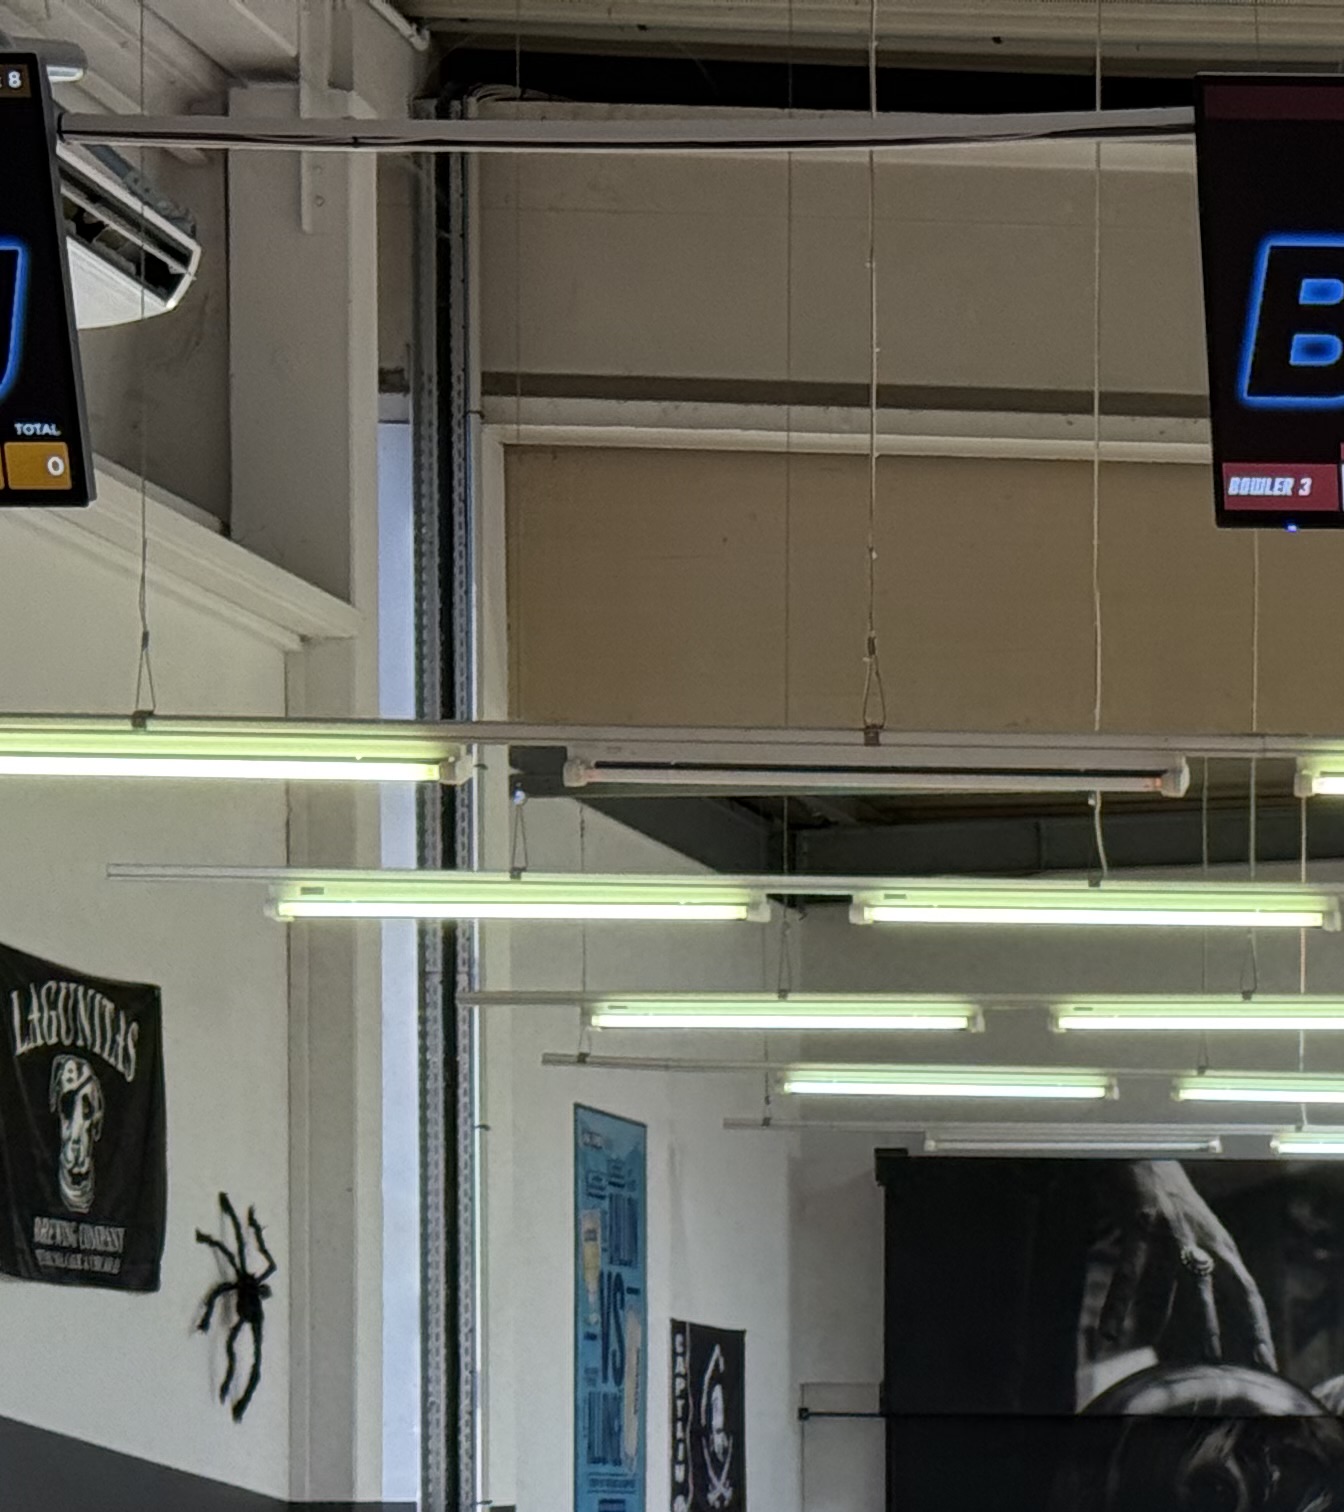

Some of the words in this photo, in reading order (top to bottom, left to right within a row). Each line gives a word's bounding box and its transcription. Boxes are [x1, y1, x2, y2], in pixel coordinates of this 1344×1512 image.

[8, 72, 21, 88] 8
[14, 423, 60, 436] TOTAL
[47, 457, 65, 476] 0
[1228, 477, 1295, 496] BOWLER
[1298, 477, 1312, 496] 3
[10, 980, 139, 1082] LAGUNITAS
